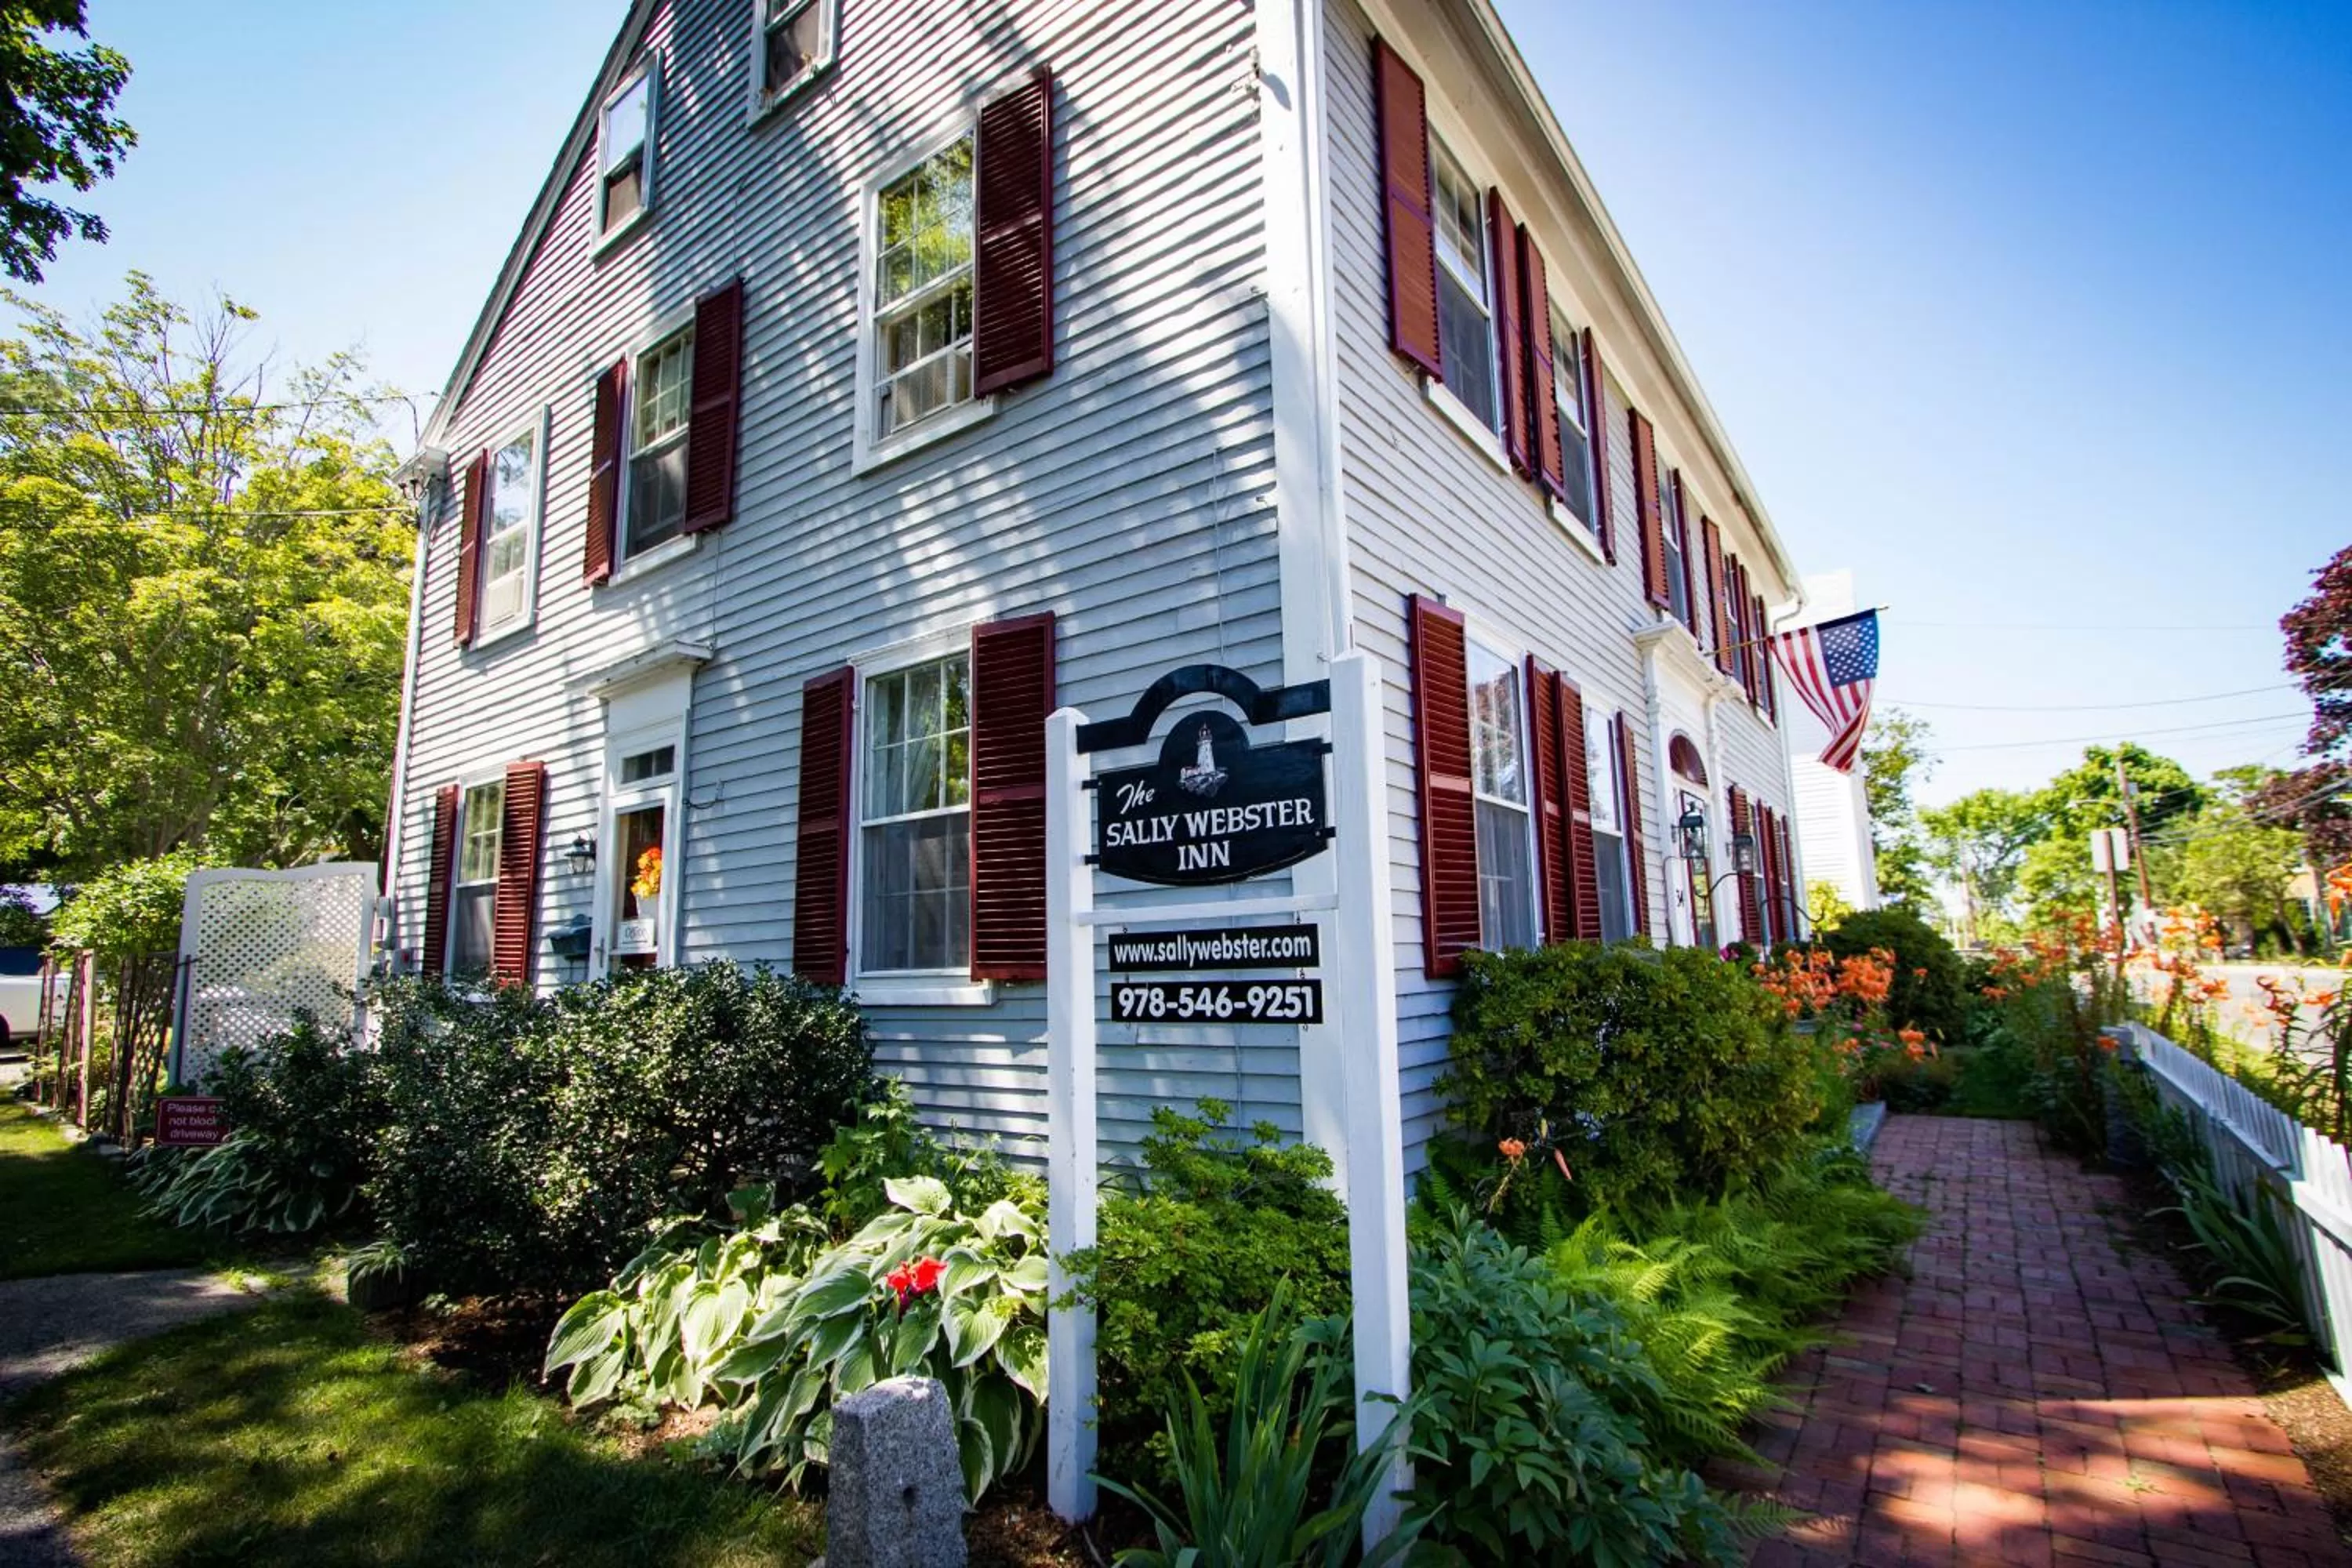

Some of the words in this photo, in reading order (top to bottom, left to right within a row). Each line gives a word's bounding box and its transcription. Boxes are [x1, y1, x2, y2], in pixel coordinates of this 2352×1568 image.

[1116, 780, 1156, 815] The
[1105, 814, 1179, 848] SALLY
[1184, 797, 1315, 839] WEBSTER
[1178, 840, 1231, 872] INN
[1114, 932, 1312, 968] www.sallywebster.com
[1118, 985, 1313, 1018] 978-546-9251
[167, 1103, 205, 1112] Please
[169, 1116, 187, 1125] not
[170, 1129, 219, 1140] driveway
